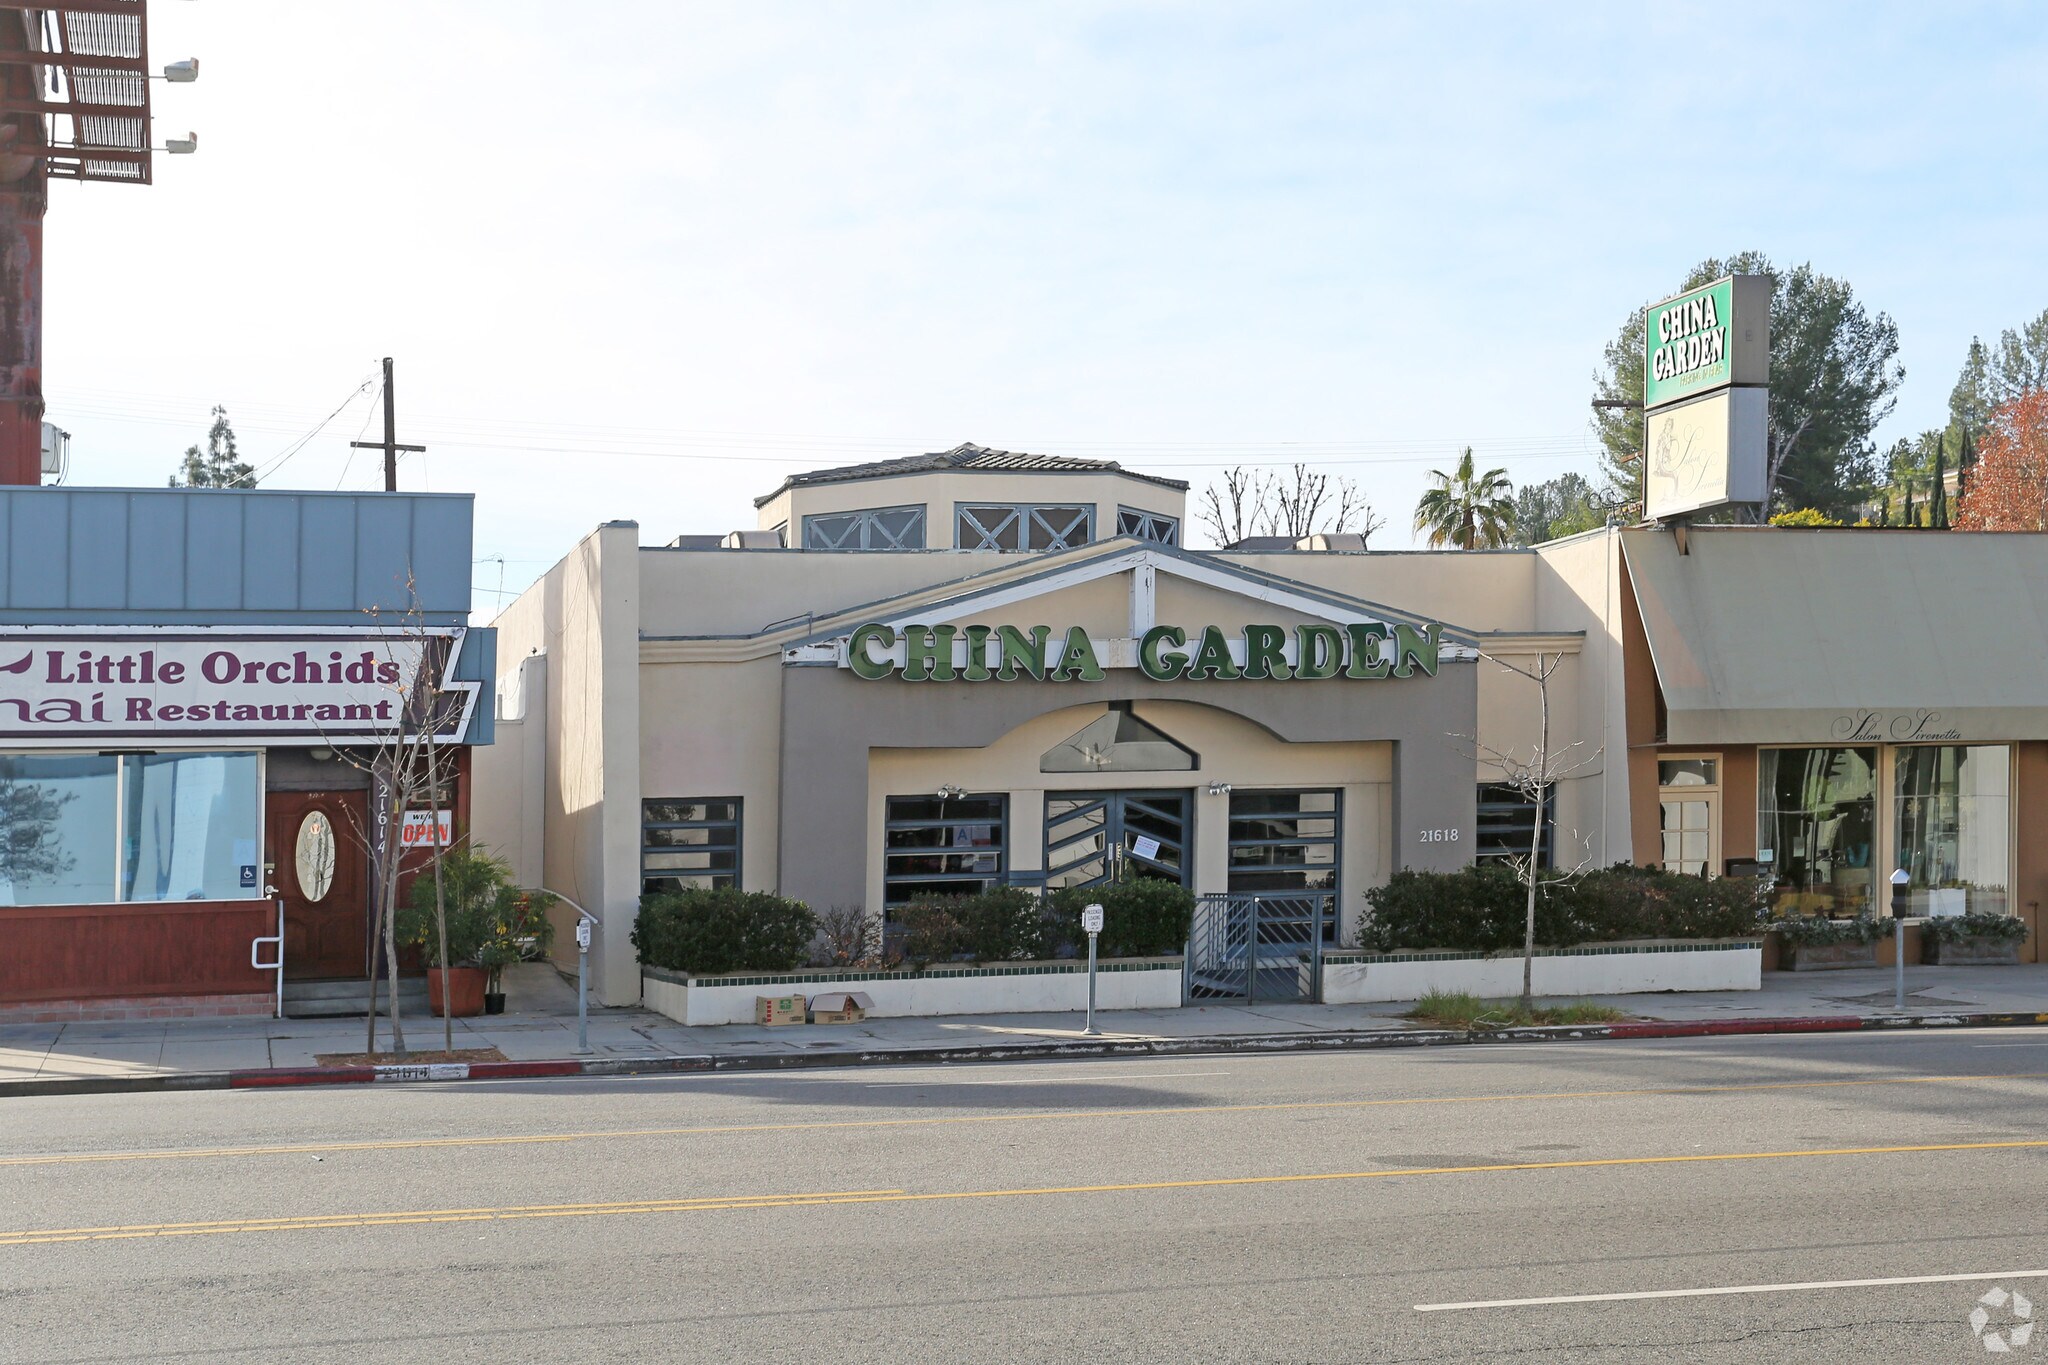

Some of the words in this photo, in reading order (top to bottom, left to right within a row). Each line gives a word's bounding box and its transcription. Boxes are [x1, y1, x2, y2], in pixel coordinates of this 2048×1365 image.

[1659, 294, 1718, 344] CHINA
[1652, 326, 1726, 382] GARDEN
[46, 650, 185, 684] Little
[201, 651, 400, 684] Orchids
[847, 622, 1106, 682] CHINA
[1138, 622, 1444, 682] GARDEN
[125, 697, 393, 721] Restaurant
[1831, 708, 1882, 740] Salon
[1890, 708, 1961, 740] Sirenetta
[377, 785, 388, 853] 21614
[957, 828, 968, 841] A
[1419, 829, 1459, 842] 21618
